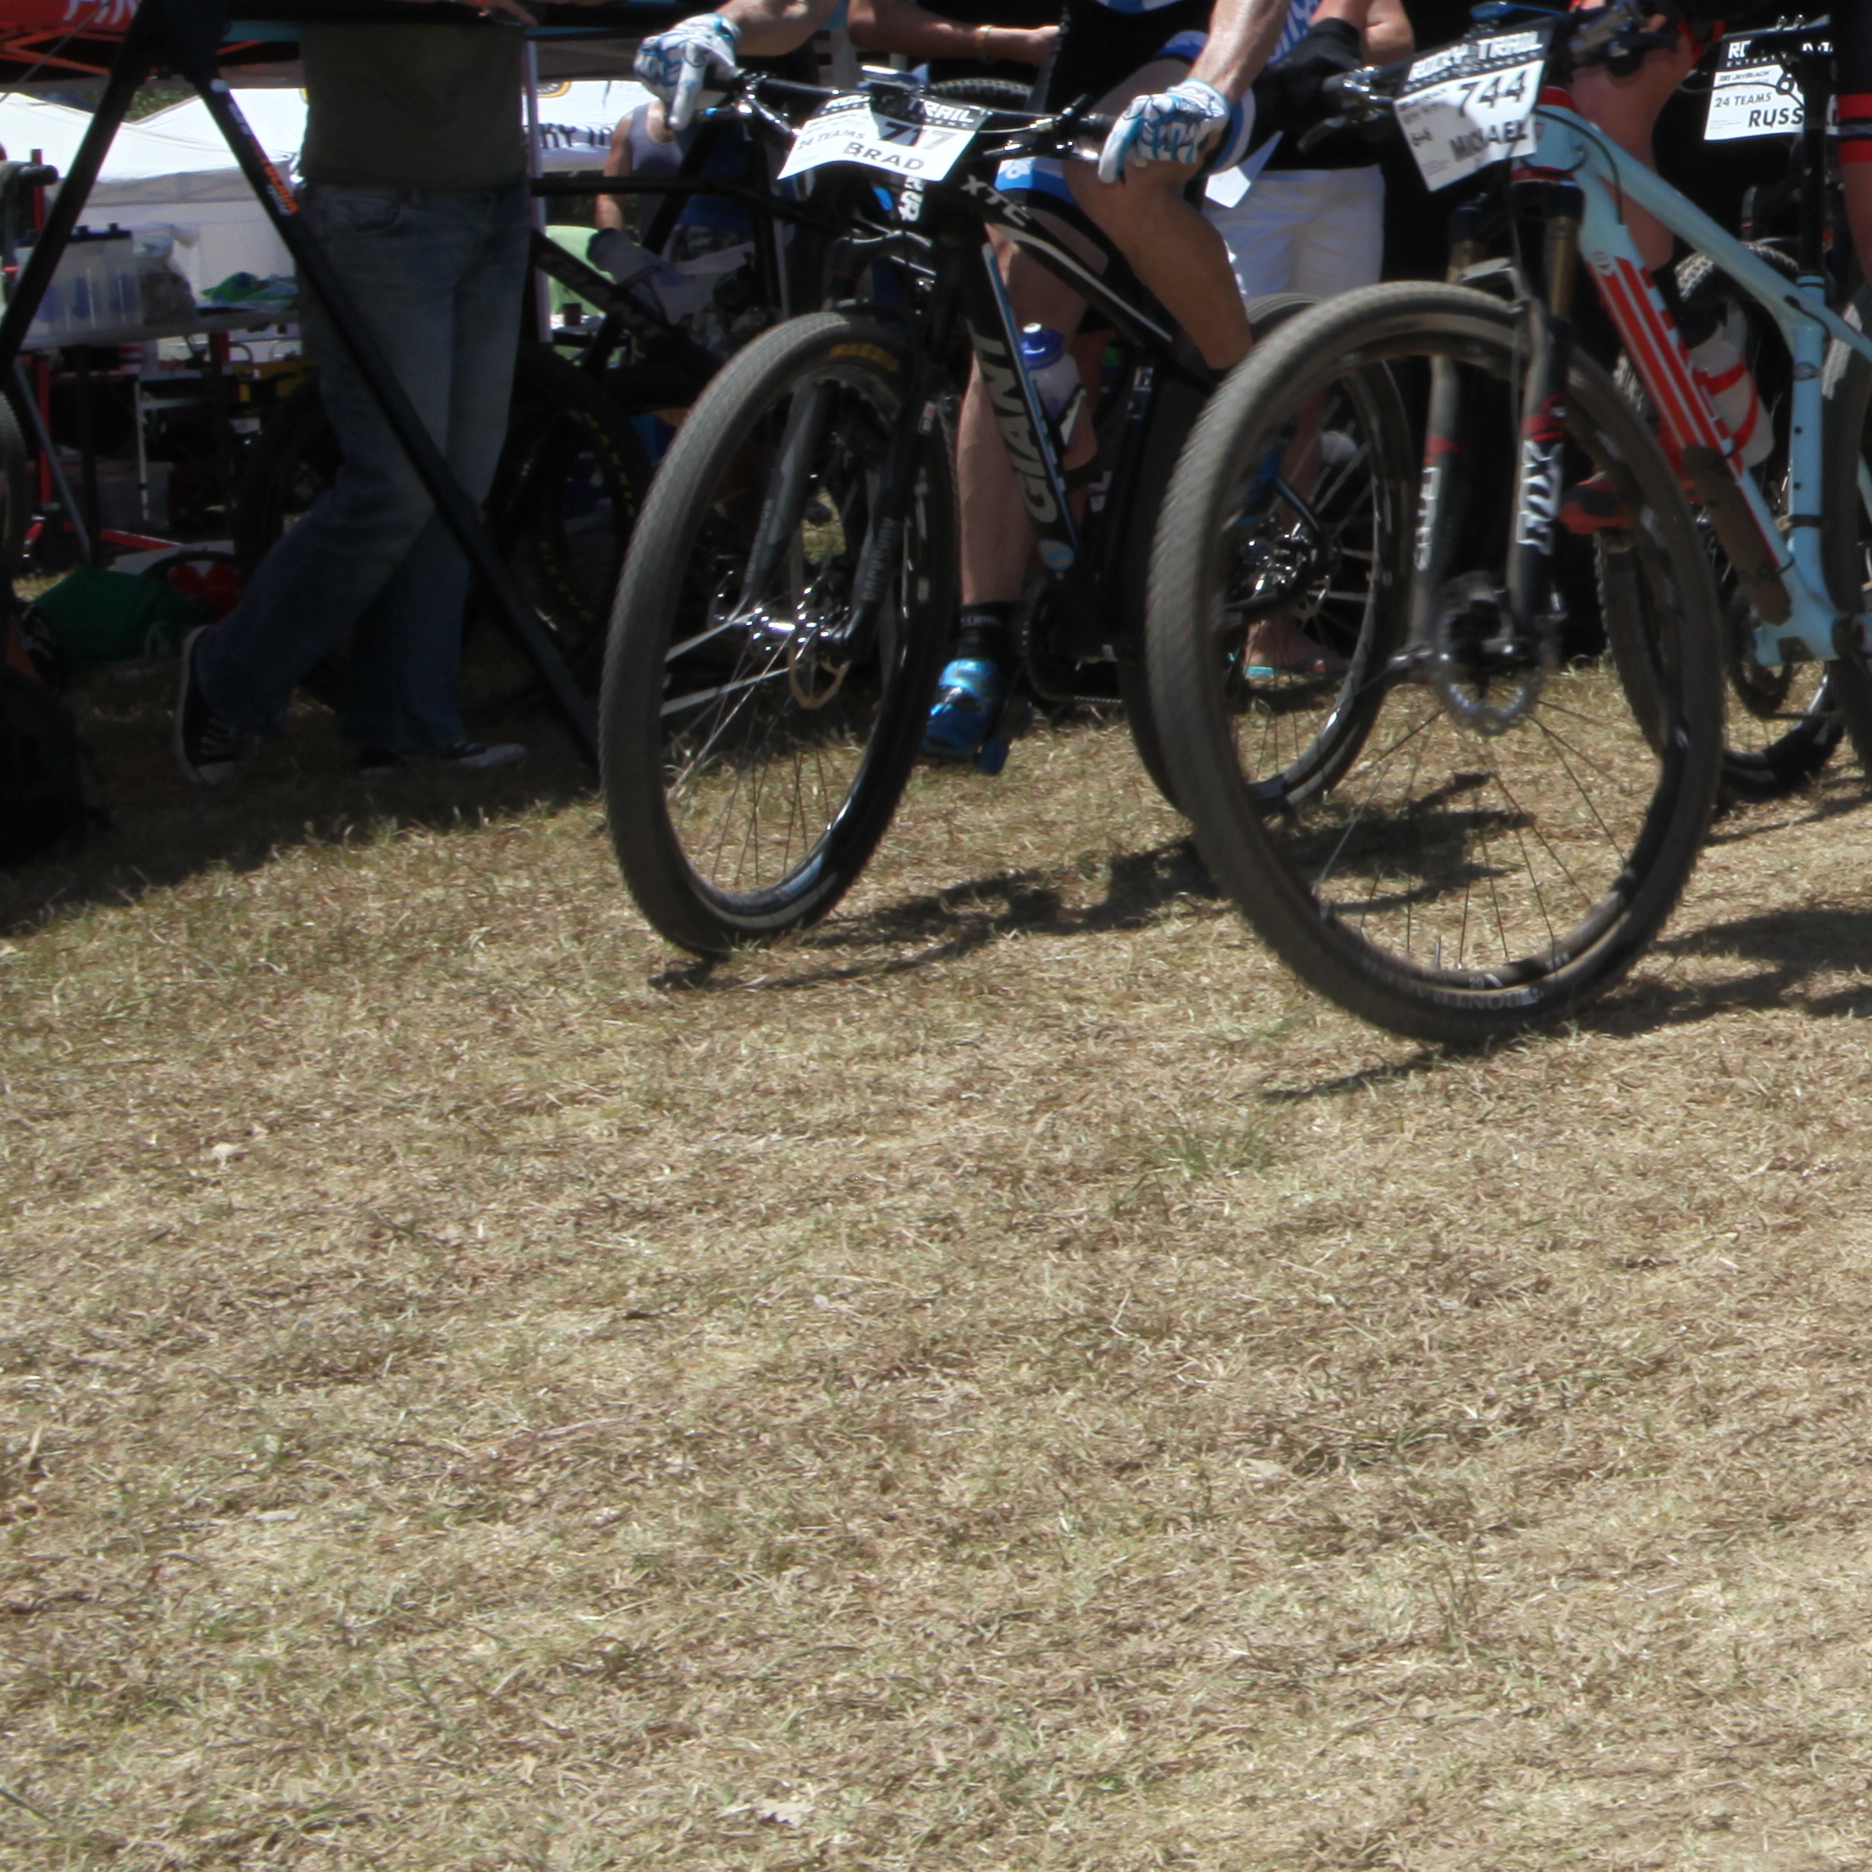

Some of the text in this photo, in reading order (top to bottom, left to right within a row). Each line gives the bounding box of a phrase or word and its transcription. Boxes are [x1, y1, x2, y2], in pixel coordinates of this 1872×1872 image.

[1460, 69, 1528, 117] 744
[1713, 91, 1773, 108] 24 TEAMS
[1747, 107, 1805, 130] RUSS
[815, 129, 866, 146] TEAMS
[842, 140, 925, 171] BRAD
[967, 318, 1059, 524] GIANT
[1515, 439, 1565, 556] FOX
